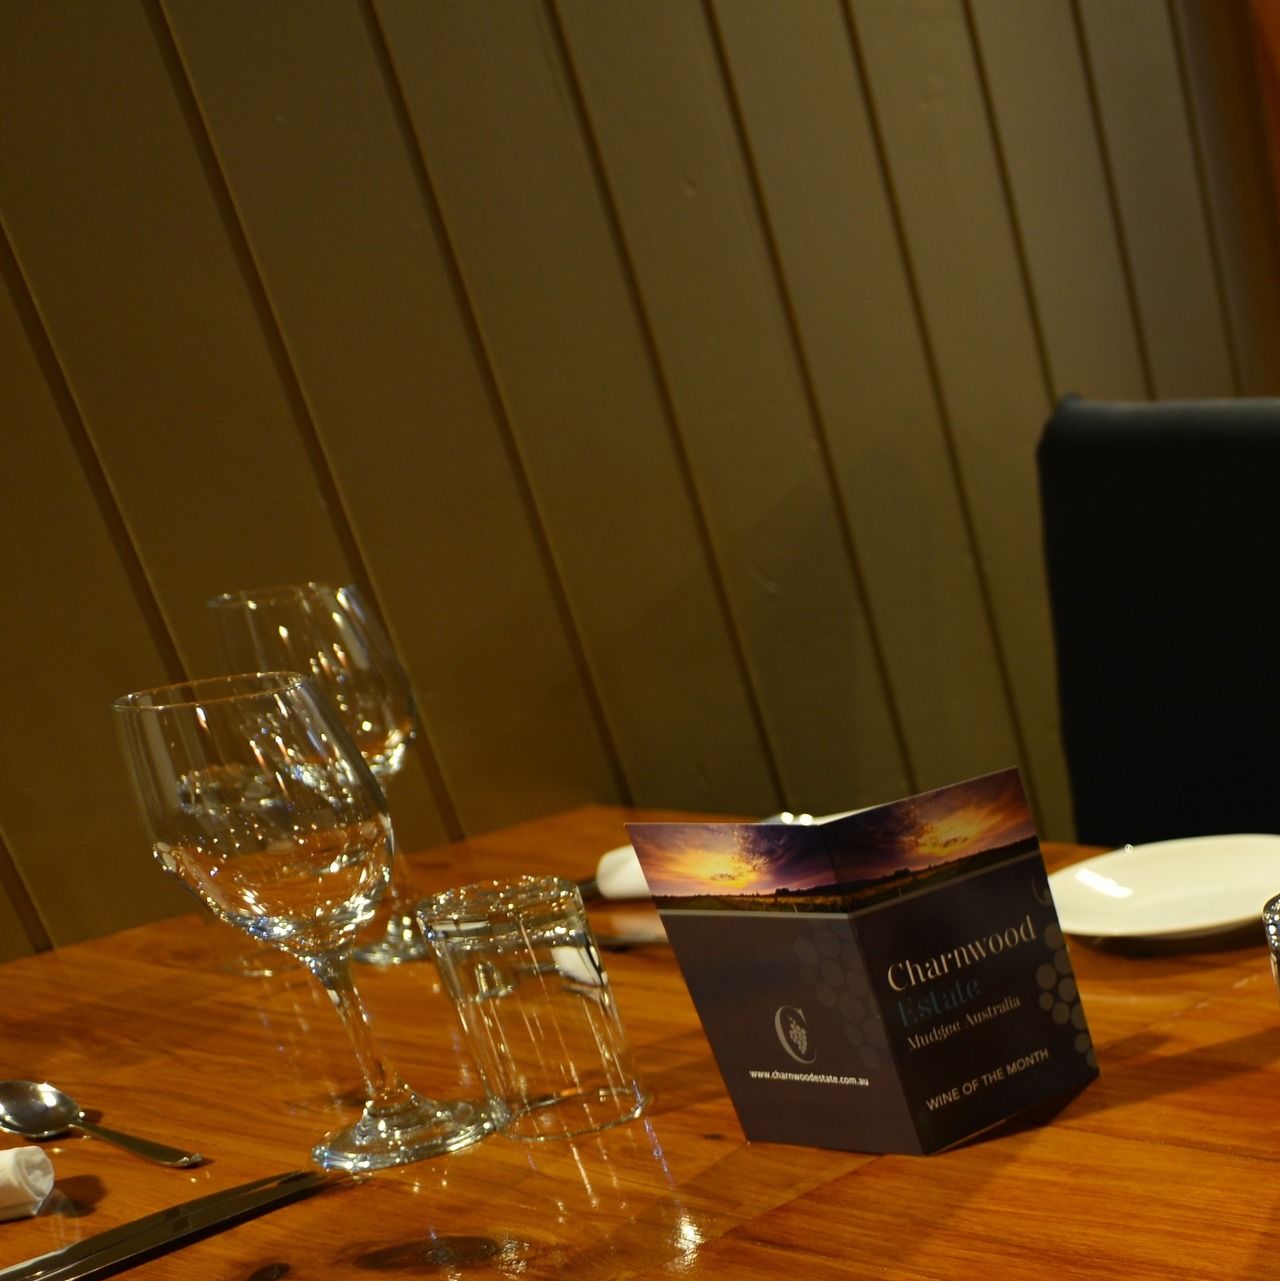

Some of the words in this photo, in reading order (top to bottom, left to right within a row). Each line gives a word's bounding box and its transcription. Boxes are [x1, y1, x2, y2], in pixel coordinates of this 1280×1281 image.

[887, 914, 1036, 992] Charnwood
[897, 979, 981, 1028] Estate
[908, 1019, 961, 1051] Mudgee
[965, 994, 1021, 1029] Australia
[749, 1069, 870, 1087] www.charnwoodestate.com.au
[926, 1086, 960, 1111] WINE
[962, 1080, 980, 1096] OF
[981, 1067, 1005, 1088] THE
[1006, 1047, 1050, 1076] MONTH
